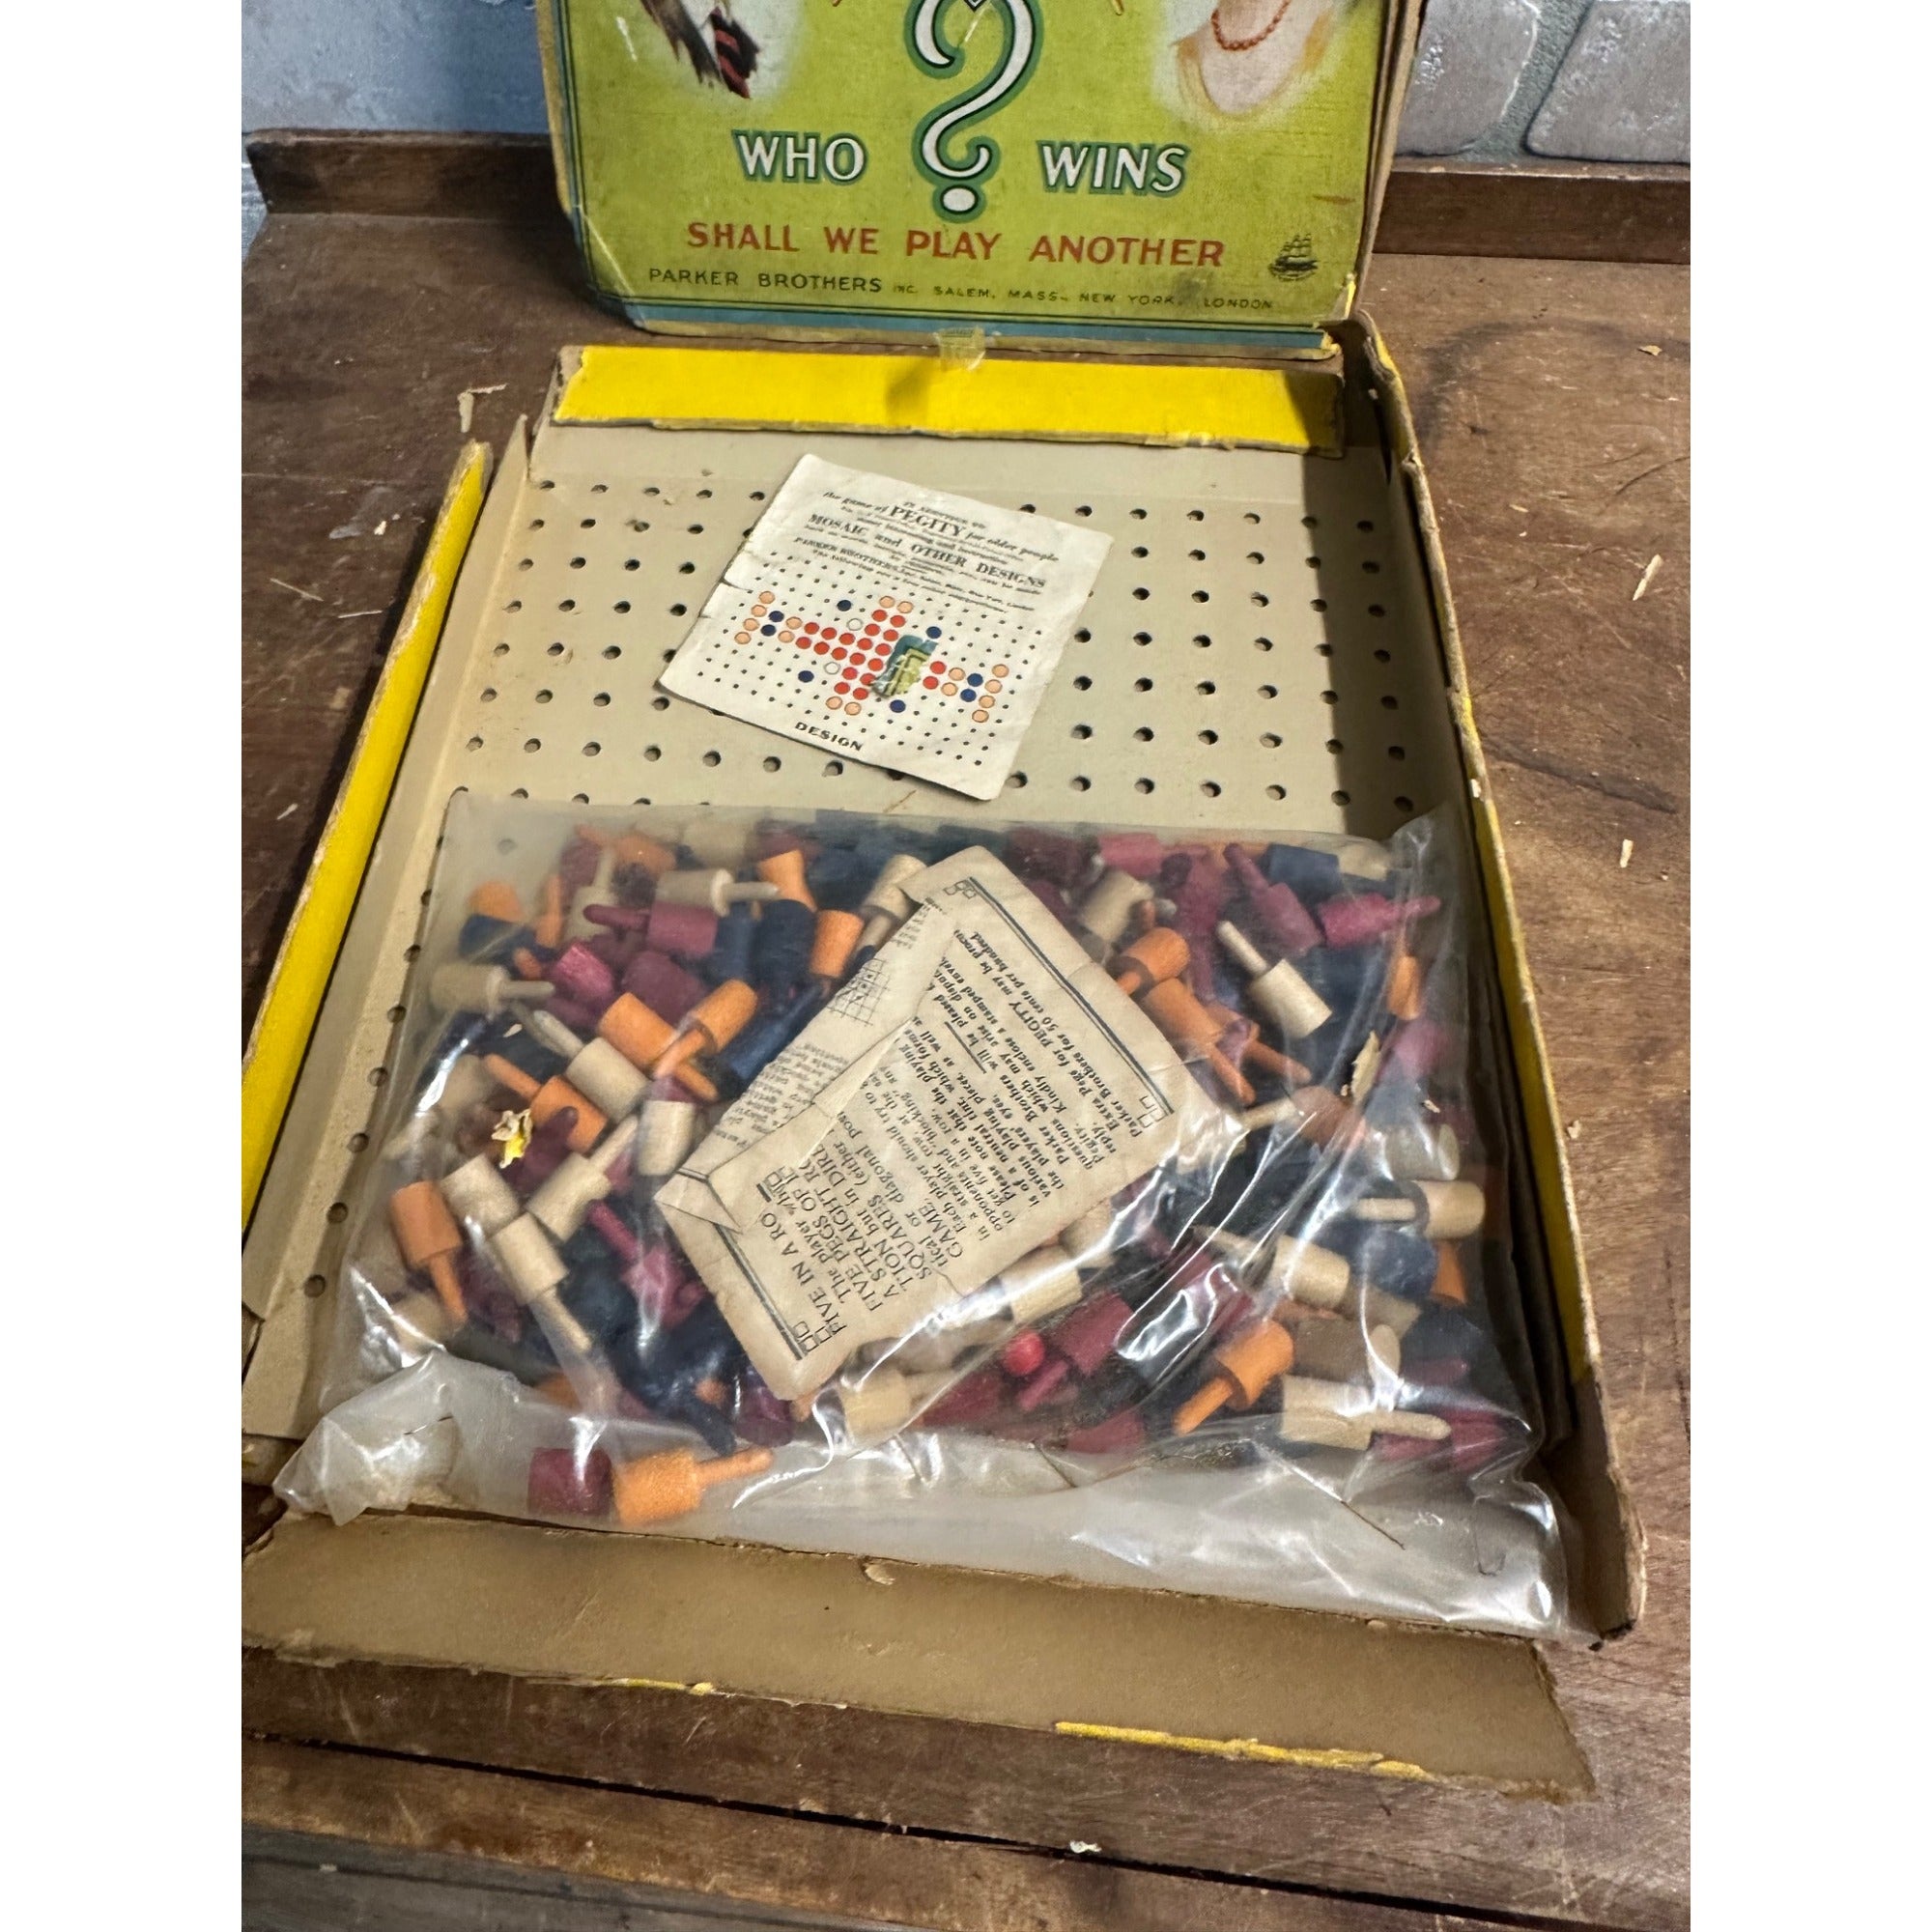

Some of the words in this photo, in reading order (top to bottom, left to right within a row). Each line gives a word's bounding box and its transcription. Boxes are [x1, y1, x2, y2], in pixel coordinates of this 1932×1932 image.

[735, 134, 867, 184] WHO
[1040, 141, 1189, 195] WINS
[687, 221, 801, 253] SHALL
[824, 226, 880, 255] WE
[906, 229, 1003, 259] PLAY
[1029, 235, 1226, 268] ANOTHER
[648, 268, 739, 287] PARKER
[758, 272, 883, 294] BROTHERS
[1080, 294, 1116, 304] NEW
[1204, 299, 1274, 309] LONDON
[841, 497, 872, 508] game
[891, 506, 965, 536] PEGITY
[965, 532, 985, 541] for
[987, 539, 1017, 551] older
[1019, 548, 1059, 561] people
[811, 514, 866, 533] MOSAIC
[874, 534, 902, 547] and
[911, 545, 967, 567] OTHER
[976, 563, 1045, 587] DESIGNS
[794, 722, 865, 752] DESIGN
[953, 929, 983, 958] procu
[939, 956, 964, 985] envelo
[980, 962, 993, 975] be
[1006, 974, 1025, 988] per
[934, 966, 962, 1001] disput
[992, 977, 1012, 995] may
[933, 995, 968, 1028] pleased
[960, 986, 997, 1024] stamped
[964, 1007, 977, 1023] on
[1021, 991, 1043, 1013] cents
[912, 1016, 923, 1026] as
[978, 1025, 999, 1046] arise
[1009, 1002, 1053, 1047] PEGITY
[1041, 1017, 1059, 1032] 50
[905, 1030, 930, 1063] forms
[920, 1031, 941, 1052] well
[967, 1034, 979, 1047] be
[1005, 1037, 1035, 1071] enclose
[1057, 1035, 1074, 1051] for
[899, 1044, 932, 1082] playing
[943, 1057, 954, 1066] as
[977, 1049, 998, 1069] will
[1000, 1053, 1020, 1074] may
[1053, 1050, 1070, 1066] for
[865, 1072, 882, 1087] sa
[880, 1066, 897, 1084] any
[928, 1062, 954, 1093] which
[1069, 1070, 1093, 1096] Pegs
[1073, 1053, 1111, 1098] Brothers
[866, 1093, 876, 1104] to
[882, 1094, 897, 1109] the
[931, 1088, 947, 1105] the
[957, 1096, 978, 1121] tint,
[992, 1094, 1012, 1120] eyes.
[1000, 1075, 1037, 1122] Brothers
[1021, 1080, 1048, 1113] which
[1035, 1076, 1066, 1113] Kindly
[838, 1111, 863, 1139] posi
[874, 1105, 890, 1123] try
[893, 1091, 937, 1148] "blocking"
[898, 1115, 910, 1125] at
[947, 1109, 967, 1131] that
[1093, 1098, 1120, 1131] Extra
[1111, 1101, 1142, 1137] Parker
[886, 1126, 918, 1162] should
[974, 1124, 1009, 1162] neutral
[983, 1108, 1019, 1151] playing
[1074, 1123, 1105, 1163] Pegity.
[1092, 1122, 1116, 1153] reply.
[936, 1149, 959, 1168] and
[958, 1149, 971, 1162] in
[968, 1136, 988, 1159] note
[1010, 1127, 1049, 1166] players'
[1039, 1126, 1069, 1164] Parker
[1052, 1119, 1095, 1170] questions
[799, 1159, 820, 1182] RO
[812, 1146, 845, 1187] DIRE
[834, 1142, 868, 1185] (either
[855, 1146, 903, 1203] diagonal
[970, 1165, 988, 1185] five
[1018, 1156, 1053, 1197] various
[917, 1165, 948, 1199] player
[933, 1164, 967, 1206] straight
[989, 1167, 1016, 1201] Please
[1012, 1179, 1029, 1191] of
[1048, 1172, 1065, 1189] the
[793, 1189, 816, 1211] OF
[844, 1188, 859, 1207] in
[958, 1172, 1003, 1231] opponents
[987, 1189, 1006, 1207] get
[1029, 1195, 1039, 1208] is
[760, 1213, 786, 1240] RO
[857, 1209, 879, 1236] but
[904, 1212, 922, 1227] or
[943, 1203, 966, 1233] Each
[1003, 1210, 1015, 1224] to
[796, 1221, 835, 1264] player
[812, 1215, 849, 1263] PEGS
[816, 1188, 885, 1281] STRAIGHT
[867, 1195, 931, 1279] SQUARES
[978, 1226, 990, 1241] in
[781, 1241, 799, 1256] A
[919, 1236, 948, 1266] tical
[792, 1262, 814, 1286] IN
[874, 1239, 913, 1291] TION
[828, 1269, 859, 1303] The
[845, 1265, 883, 1311] FIVE
[883, 1284, 899, 1297] A
[810, 1288, 846, 1335] FIVE
